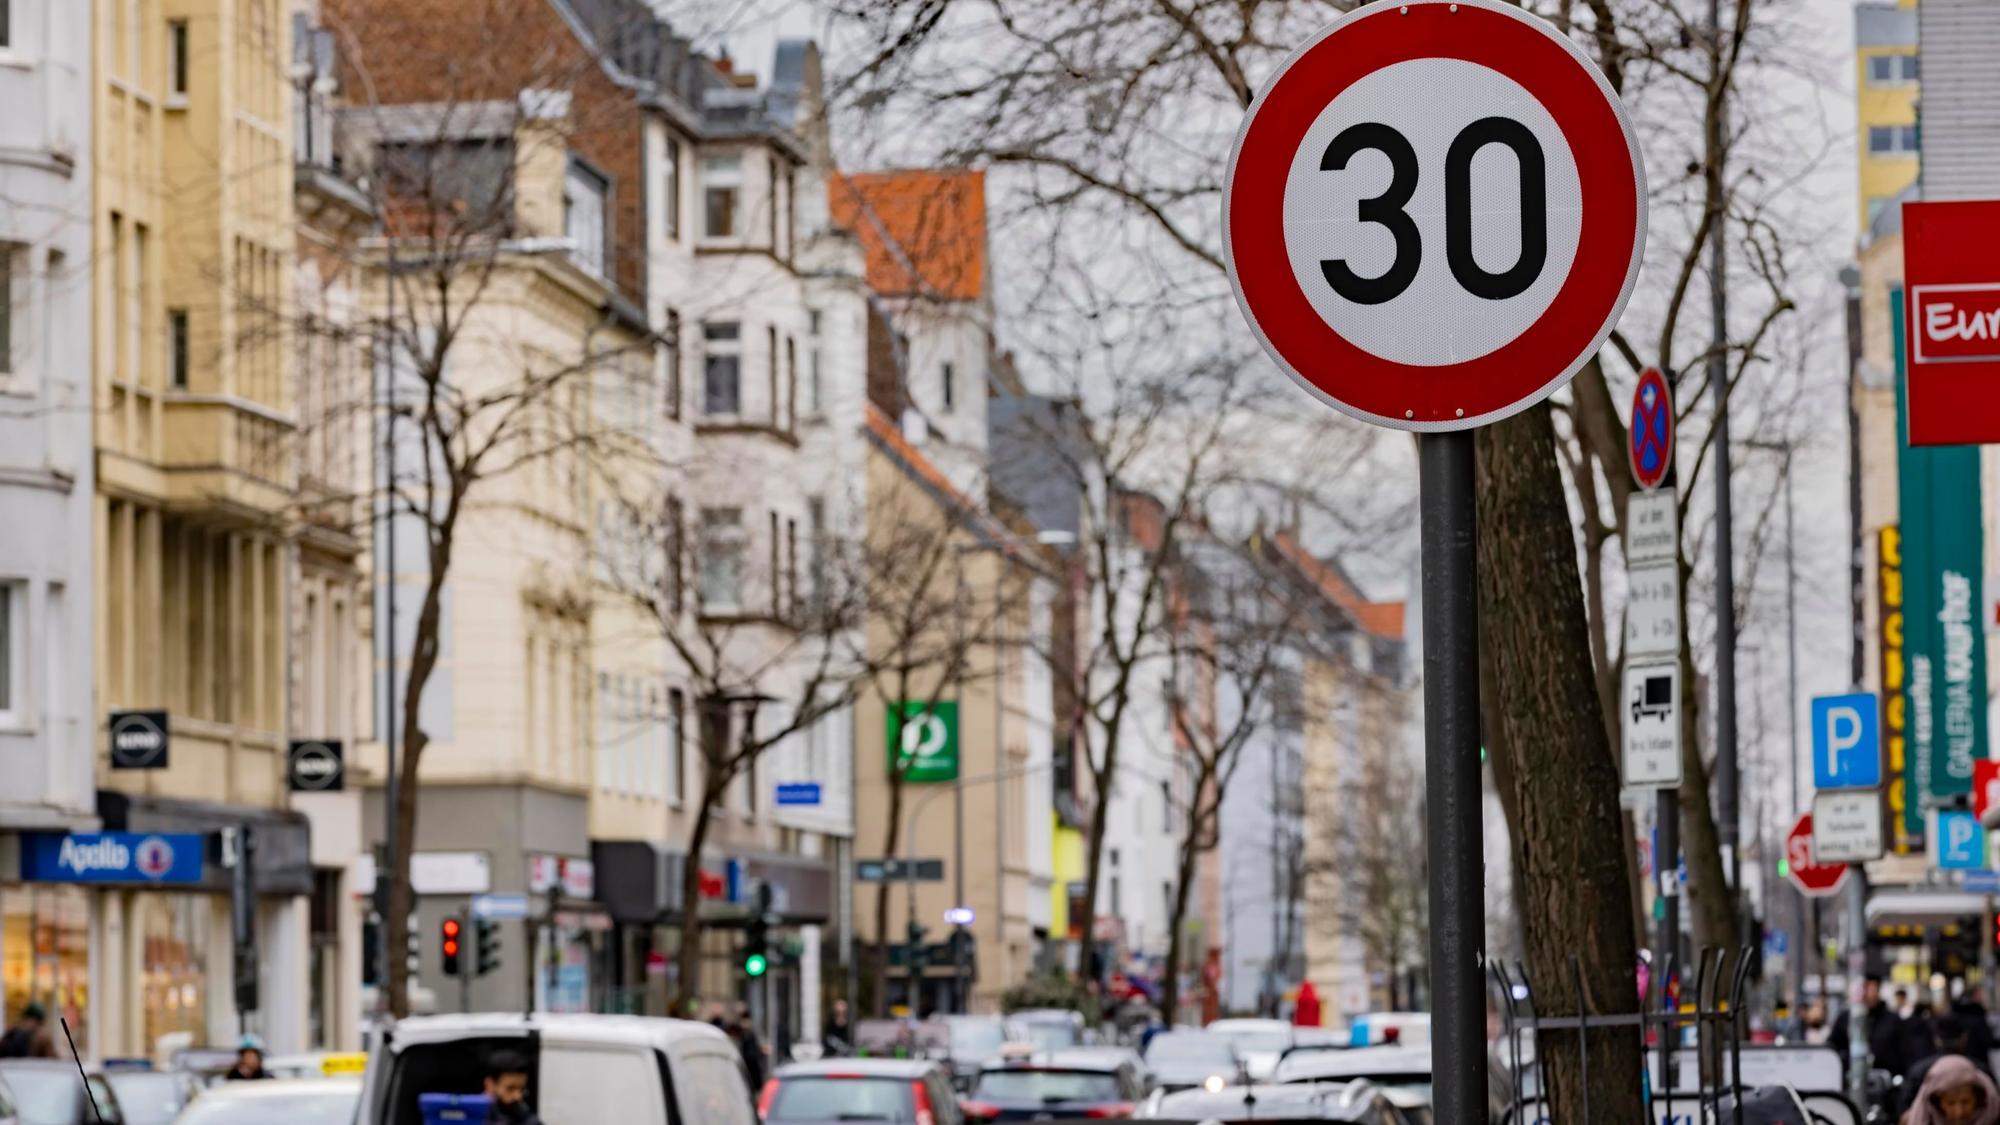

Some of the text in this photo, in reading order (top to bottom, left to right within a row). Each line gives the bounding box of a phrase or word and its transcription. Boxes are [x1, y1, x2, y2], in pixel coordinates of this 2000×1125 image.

[1320, 116, 1547, 305] 30
[1827, 706, 1863, 777] P
[58, 836, 129, 878] Apollo
